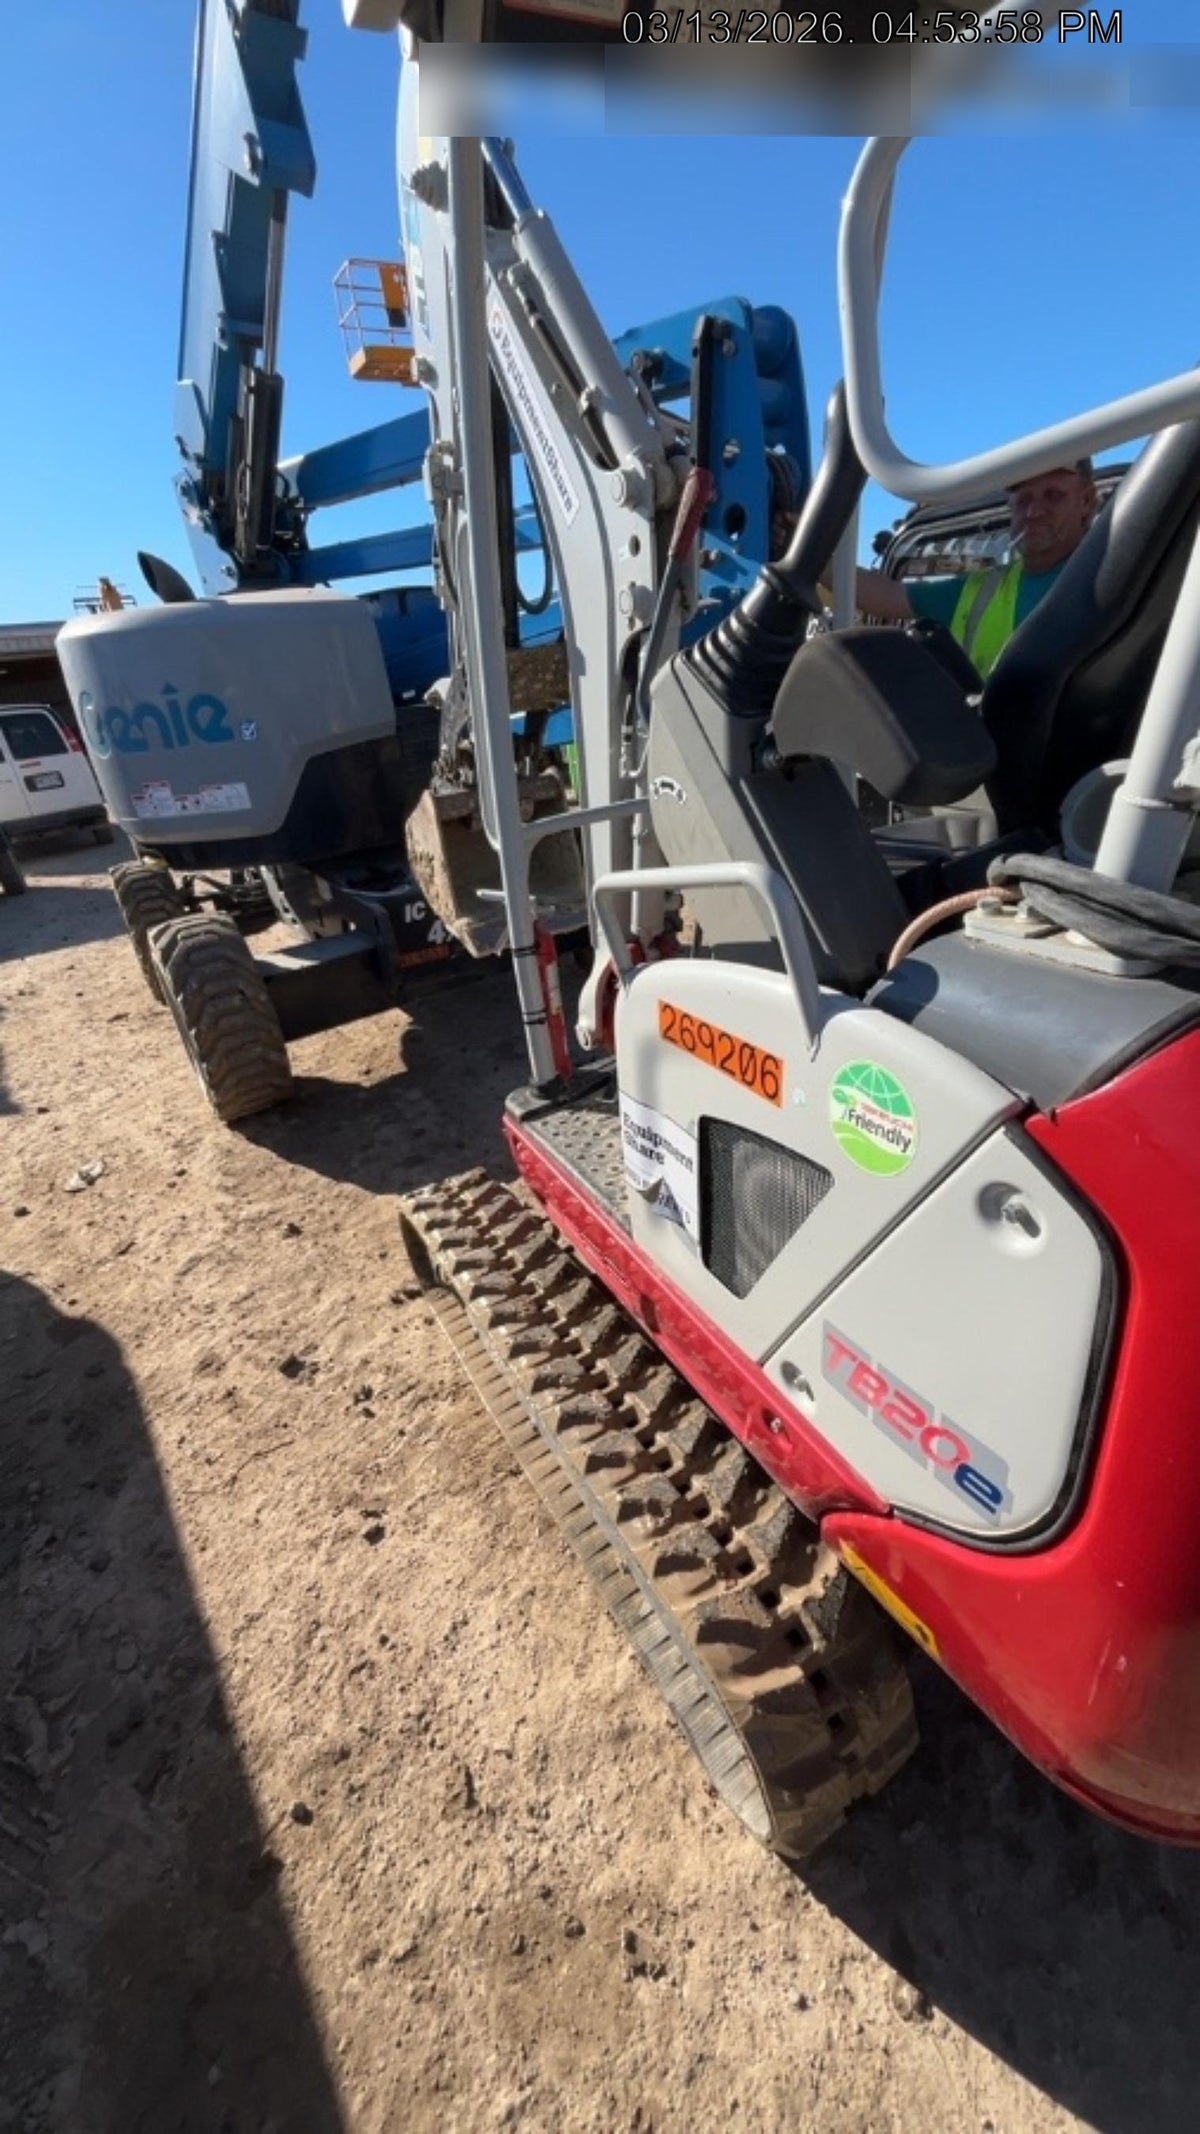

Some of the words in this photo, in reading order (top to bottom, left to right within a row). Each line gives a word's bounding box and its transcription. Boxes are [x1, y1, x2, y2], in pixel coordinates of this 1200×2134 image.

[79, 682, 235, 760] Genie
[660, 1004, 780, 1101] 269206
[623, 1111, 695, 1173] Equipment
[624, 1130, 665, 1165] Share
[826, 1331, 1003, 1515] TB20e
